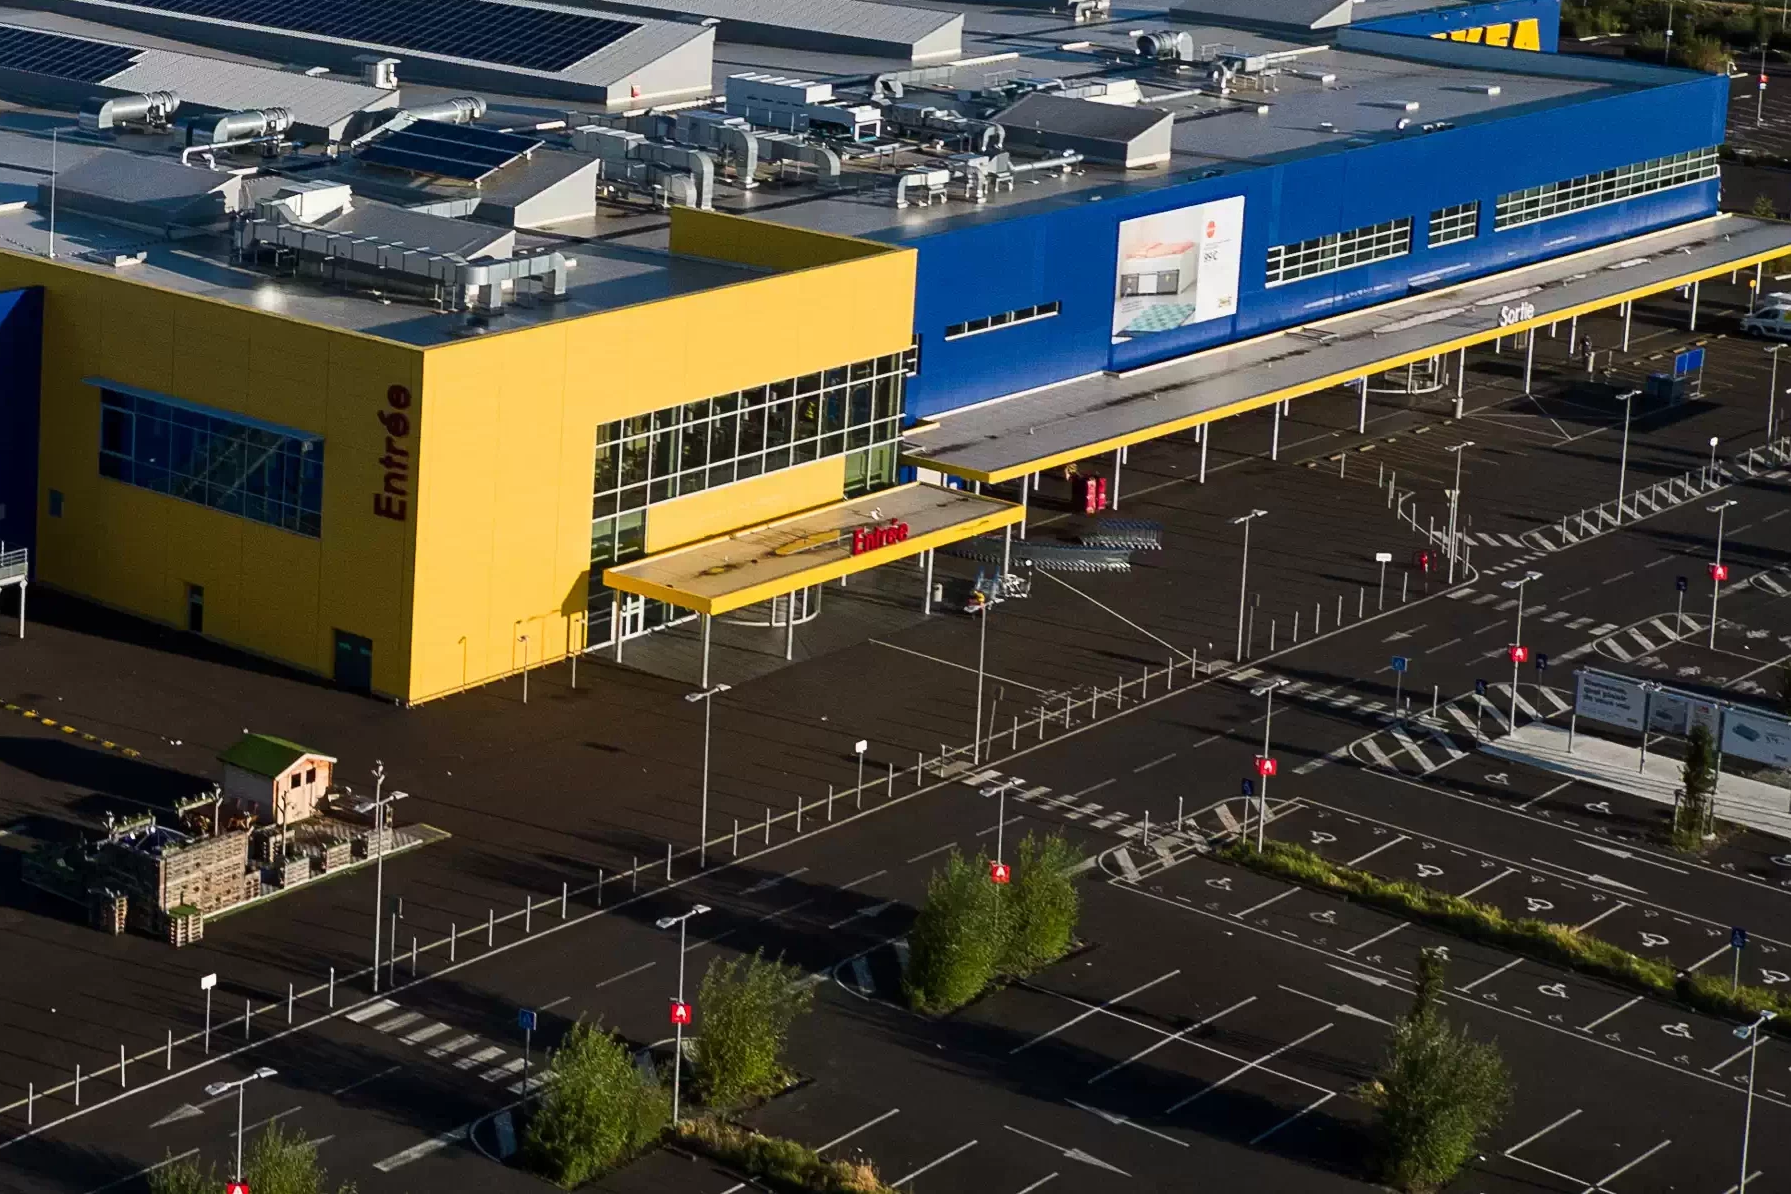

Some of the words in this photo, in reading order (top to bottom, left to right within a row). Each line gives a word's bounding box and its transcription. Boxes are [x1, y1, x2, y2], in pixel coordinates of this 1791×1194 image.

[1430, 18, 1541, 52] EA
[1499, 302, 1535, 327] Sortie
[374, 384, 412, 521] Entrée
[852, 518, 909, 556] Entrée
[676, 1005, 687, 1022] A
